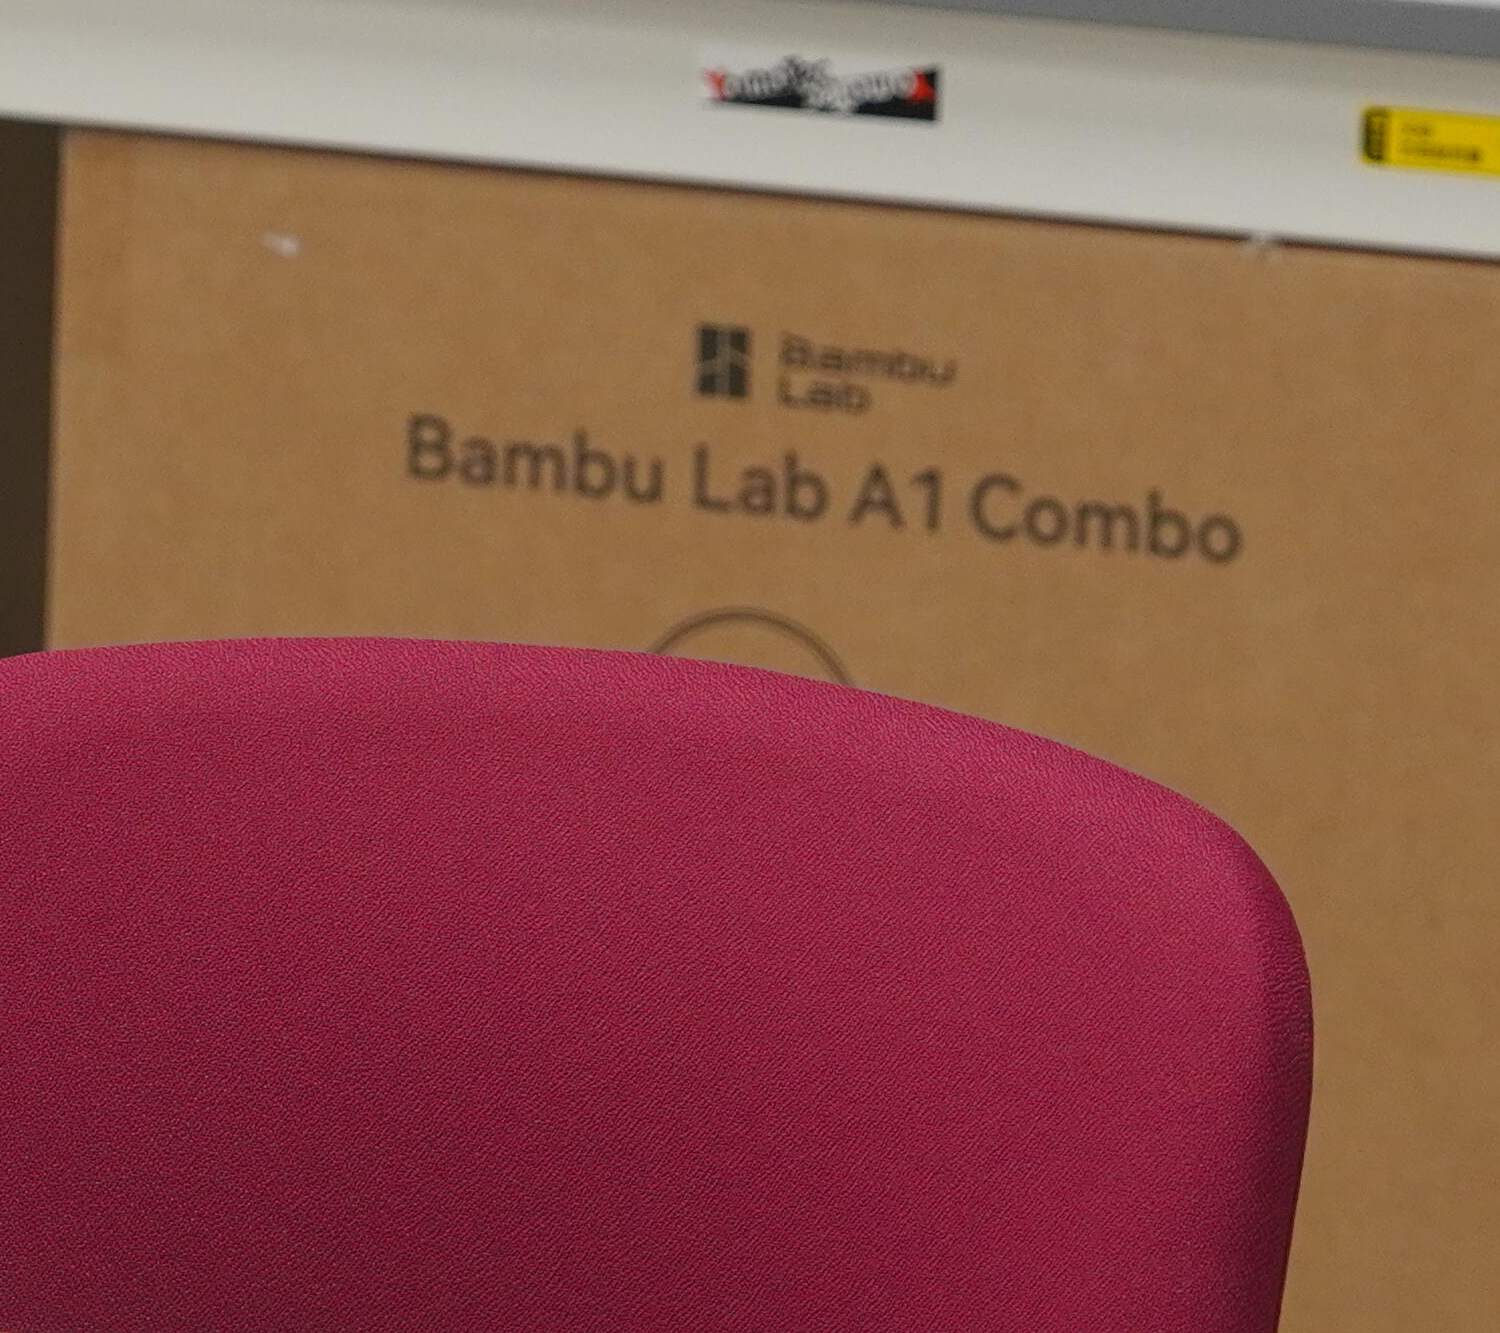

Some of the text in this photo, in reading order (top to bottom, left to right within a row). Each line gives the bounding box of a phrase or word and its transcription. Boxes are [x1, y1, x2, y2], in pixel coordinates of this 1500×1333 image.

[778, 333, 957, 389] Bambu
[777, 373, 871, 416] Lab
[406, 413, 1244, 566] Bambu Lab A1 Combo
